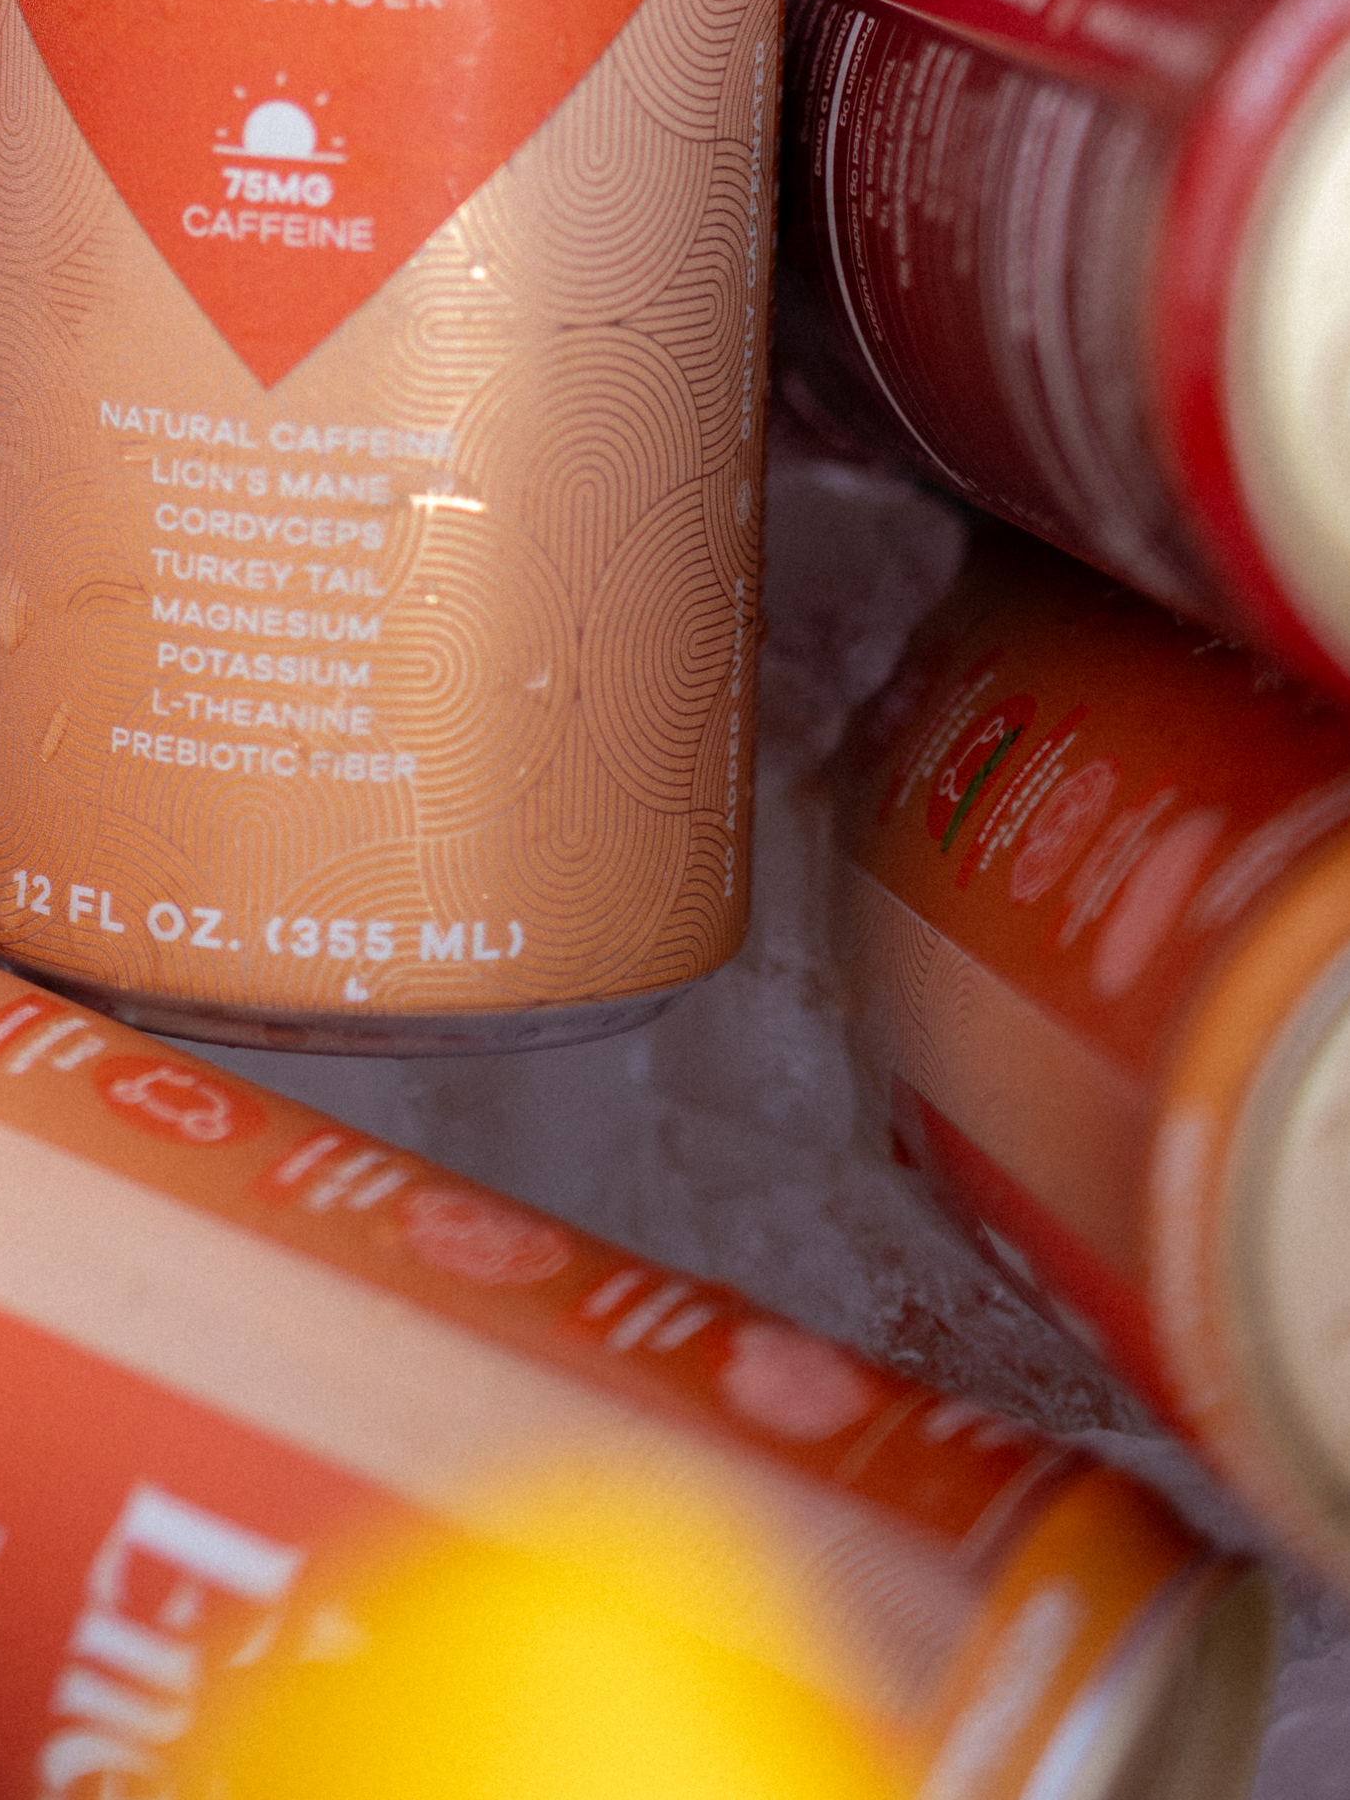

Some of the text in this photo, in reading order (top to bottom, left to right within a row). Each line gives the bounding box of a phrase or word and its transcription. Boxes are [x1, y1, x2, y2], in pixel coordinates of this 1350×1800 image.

[824, 8, 855, 91] Vitamin
[838, 16, 876, 128] Protein 0g
[222, 166, 334, 208] 75MG
[850, 73, 885, 343] Included 0g added sugars
[181, 204, 375, 252] CAFFEINE
[741, 304, 755, 441] GENTLY
[99, 400, 457, 460] NATURAL CAFFEINE
[151, 456, 392, 506] LION'S MANE
[154, 502, 386, 551] CORDYCEPS
[149, 546, 387, 598] TURKEY TAIL
[151, 594, 380, 644] MAGNESIUM
[157, 641, 372, 689] POTASSIUM
[151, 687, 372, 736] L-THEANINE
[110, 726, 418, 783] PREBIOTIC FIBER
[726, 710, 740, 832] ADDED
[723, 845, 736, 898] NO
[11, 869, 525, 962] 12 FL OZ. (355 ML)
